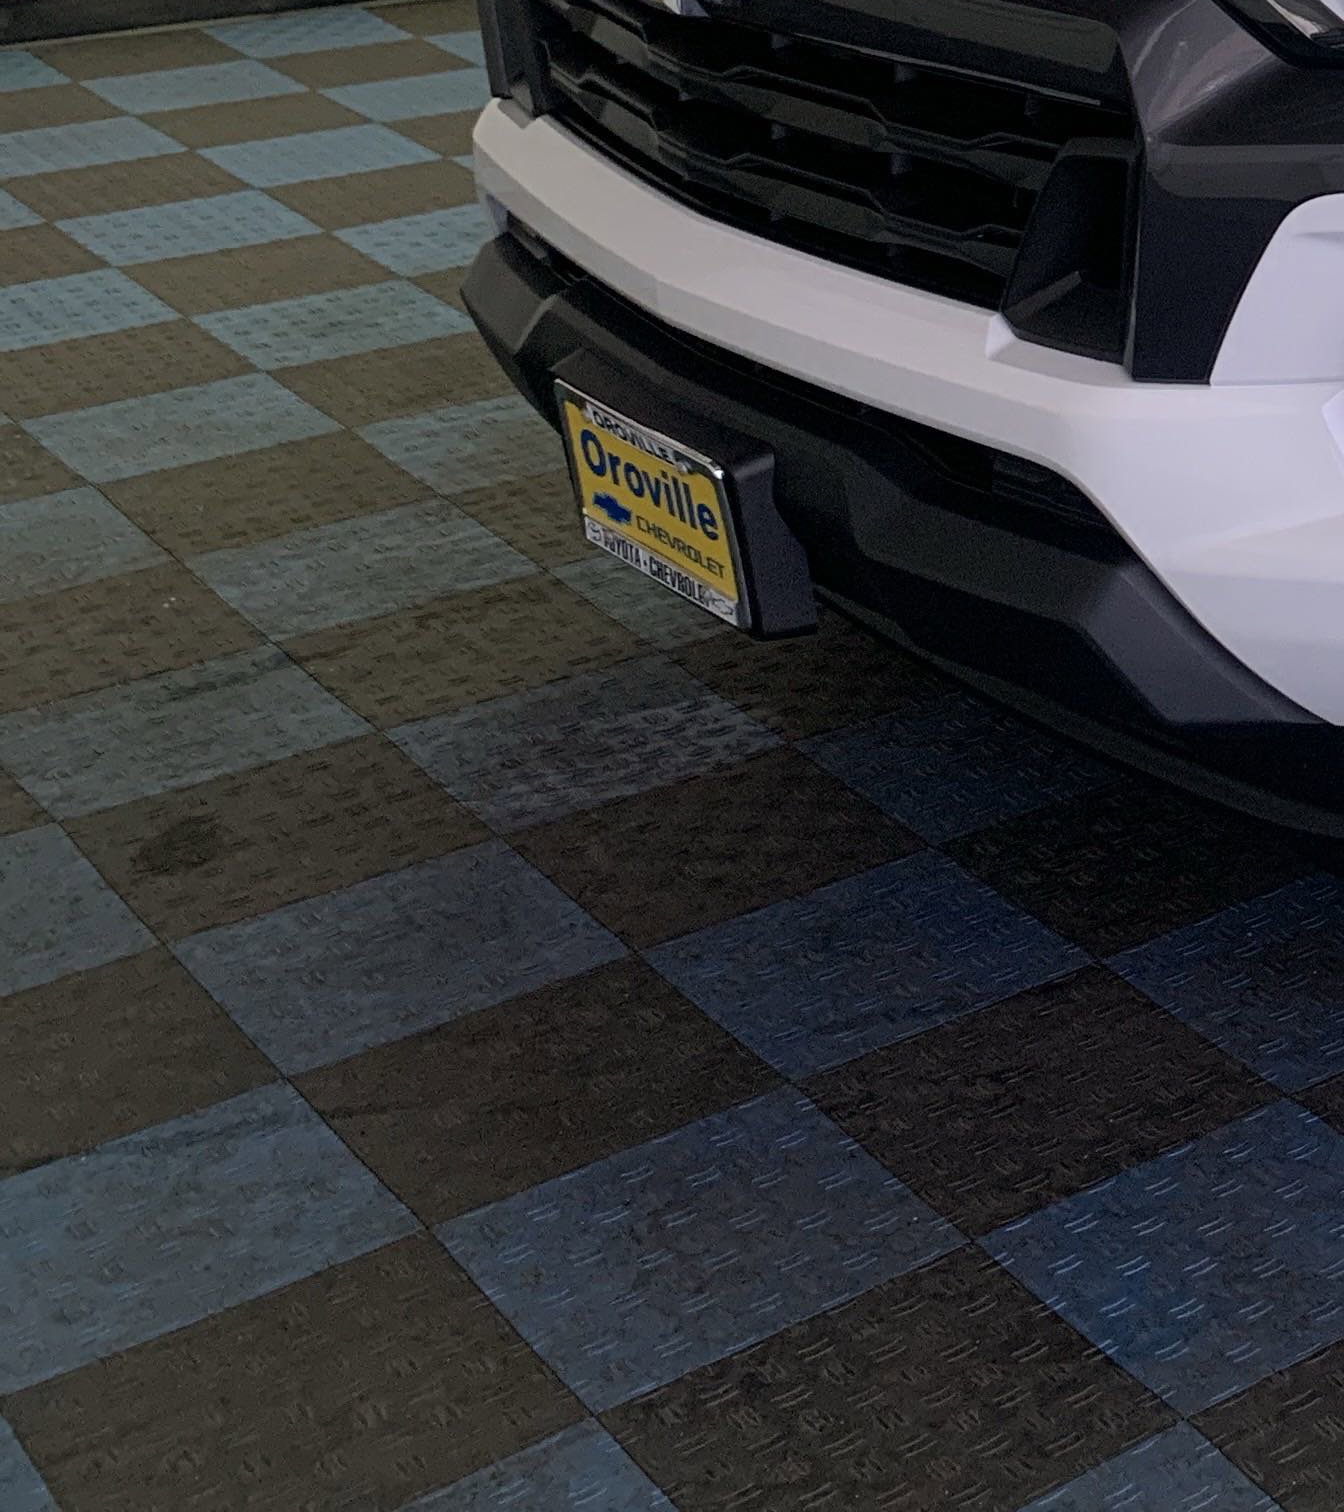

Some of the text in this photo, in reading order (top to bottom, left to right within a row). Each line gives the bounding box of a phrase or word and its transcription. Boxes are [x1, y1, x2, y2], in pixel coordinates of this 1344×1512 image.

[593, 409, 675, 466] OROVILLE
[580, 429, 719, 541] Oroville
[635, 514, 726, 579] CHEVROLET
